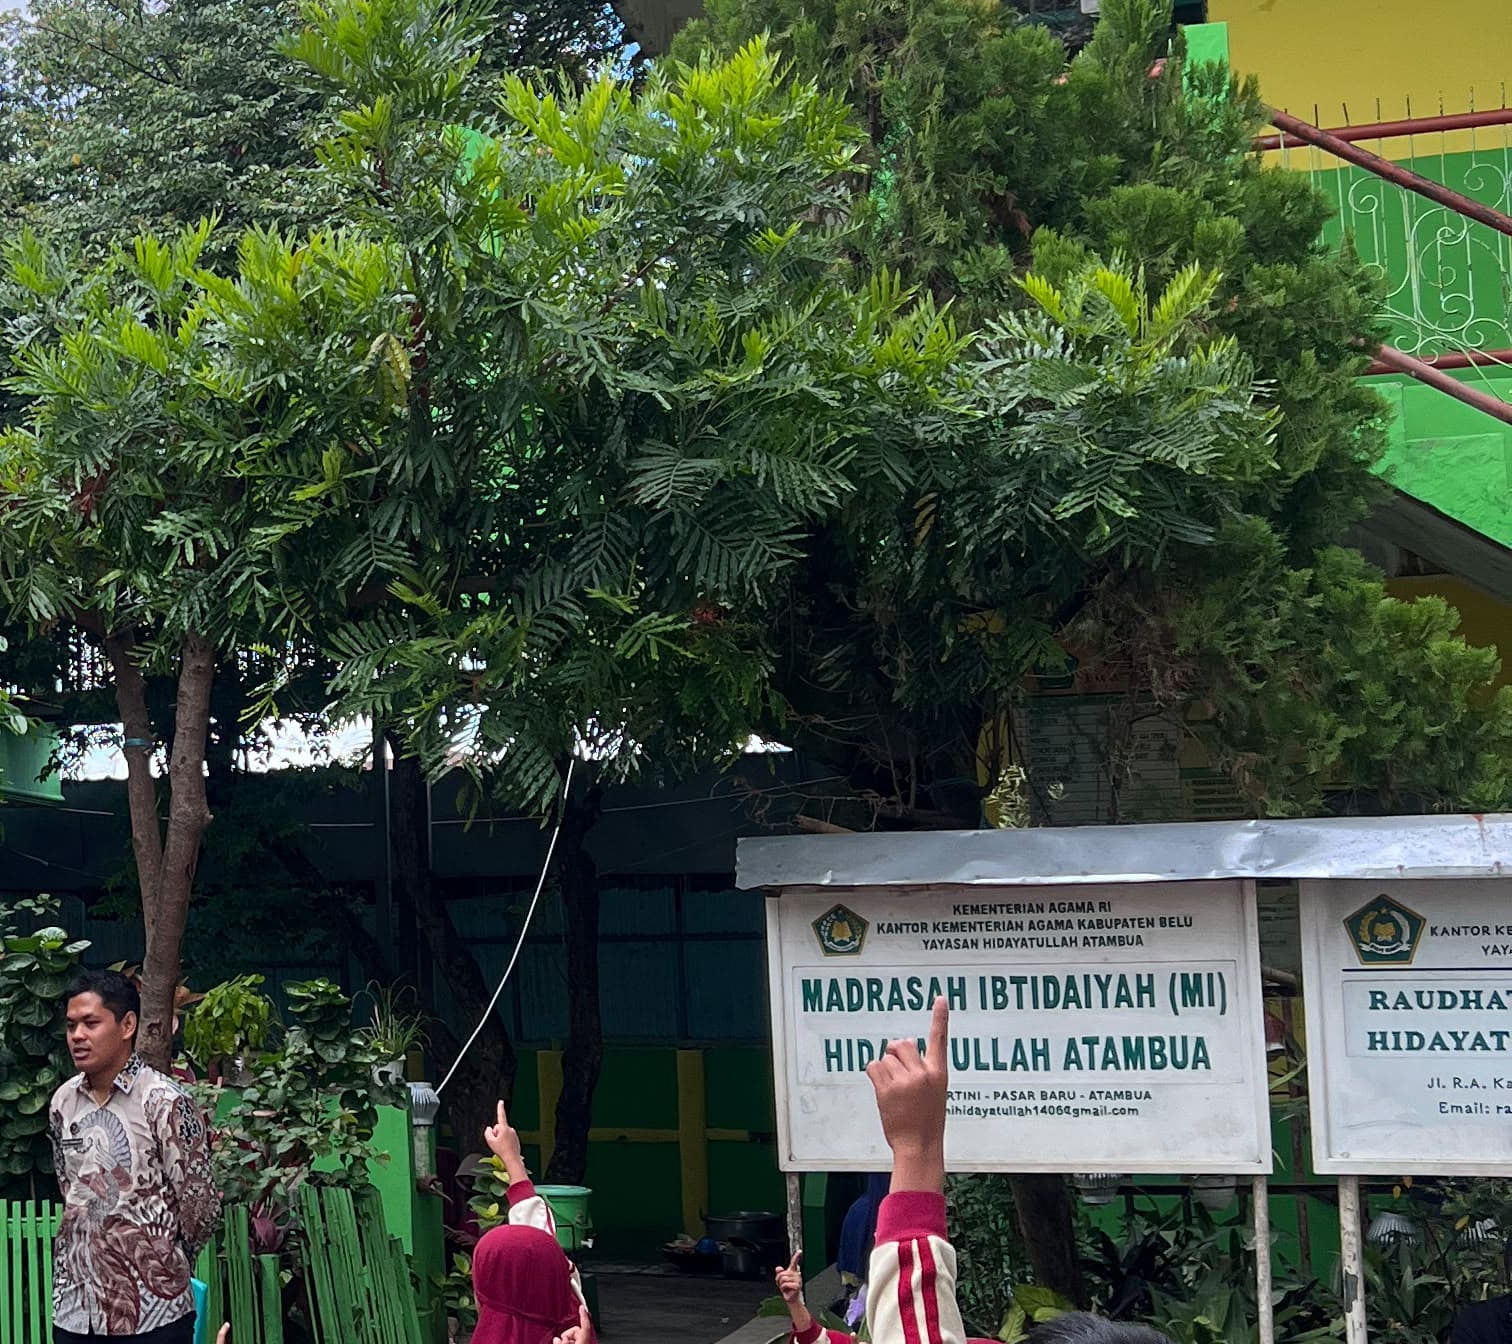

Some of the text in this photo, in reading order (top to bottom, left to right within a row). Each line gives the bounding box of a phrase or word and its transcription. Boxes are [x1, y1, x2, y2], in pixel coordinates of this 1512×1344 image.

[953, 900, 1111, 916] KEMENTERIAN AGAMA RI
[877, 916, 1193, 934] KANTOR KEMENTERIAN AGAMA KABUPATEN BELU
[1430, 925, 1491, 937] KANTOR
[922, 935, 1144, 951] YAYASAN HIDAYATULLAH ATAMBUA
[1481, 944, 1512, 957] YAY
[801, 971, 1227, 1016] MADRASAH IBTIDAIYAH (MI)
[824, 1035, 1212, 1072] HIDULLAH ATAMBUA
[1452, 1076, 1487, 1089] R.A.
[993, 1090, 1036, 1101] PASAR
[1040, 1090, 1076, 1100] BARU
[1088, 1090, 1152, 1100] ATAMBUA
[1439, 1101, 1490, 1115] Email:
